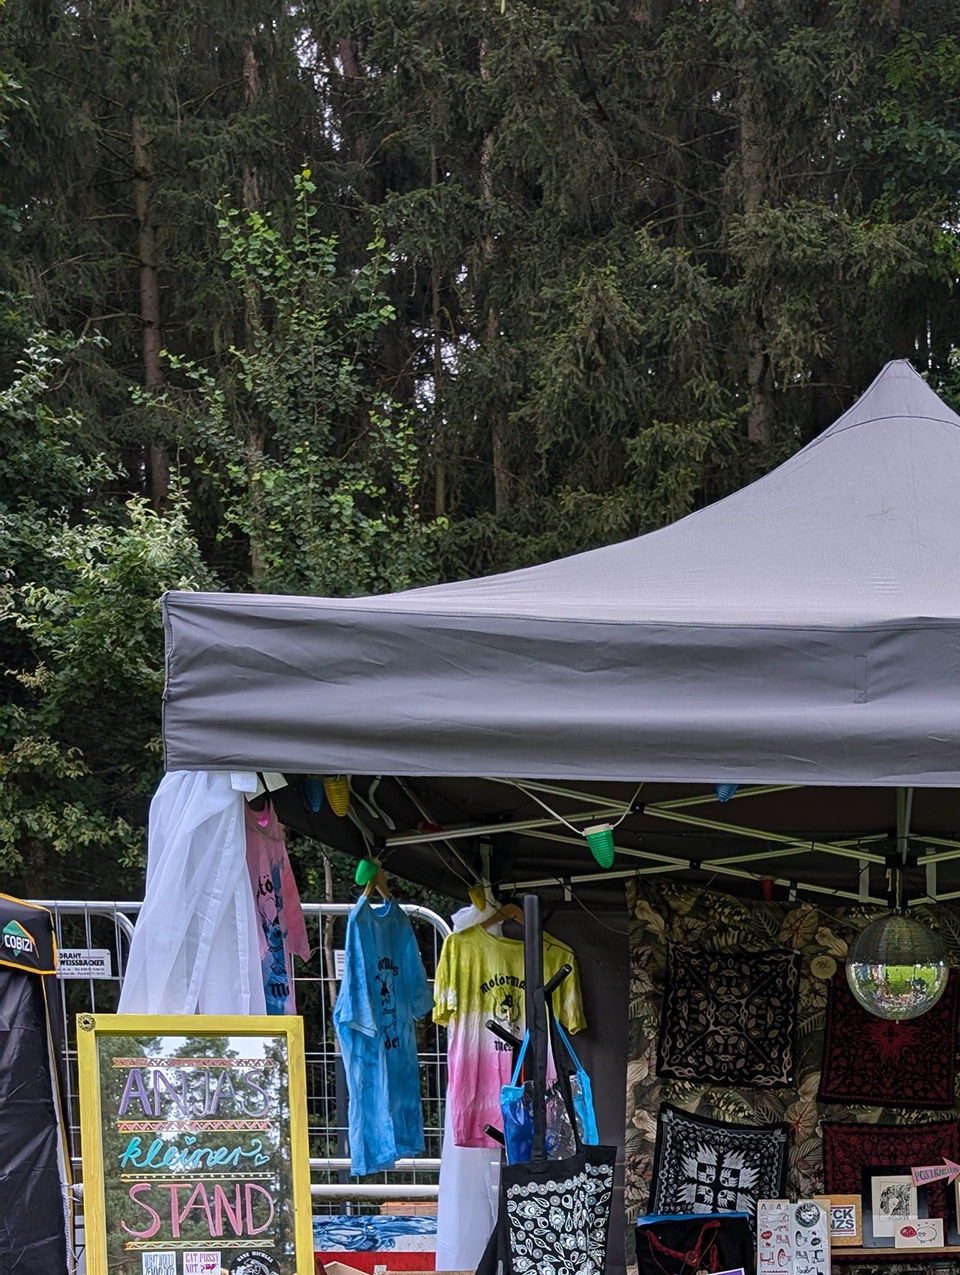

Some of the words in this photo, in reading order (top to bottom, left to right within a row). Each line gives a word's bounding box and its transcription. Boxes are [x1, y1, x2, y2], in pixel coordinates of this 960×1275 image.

[480, 973, 525, 995] motörma
[118, 1068, 271, 1118] ANJAS
[118, 1136, 264, 1169] kleiner
[120, 1182, 275, 1239] STAND
[830, 1209, 854, 1220] CK
[185, 1253, 198, 1263] EAT
[199, 1253, 219, 1262] PUSSY
[185, 1264, 198, 1273] NOT
